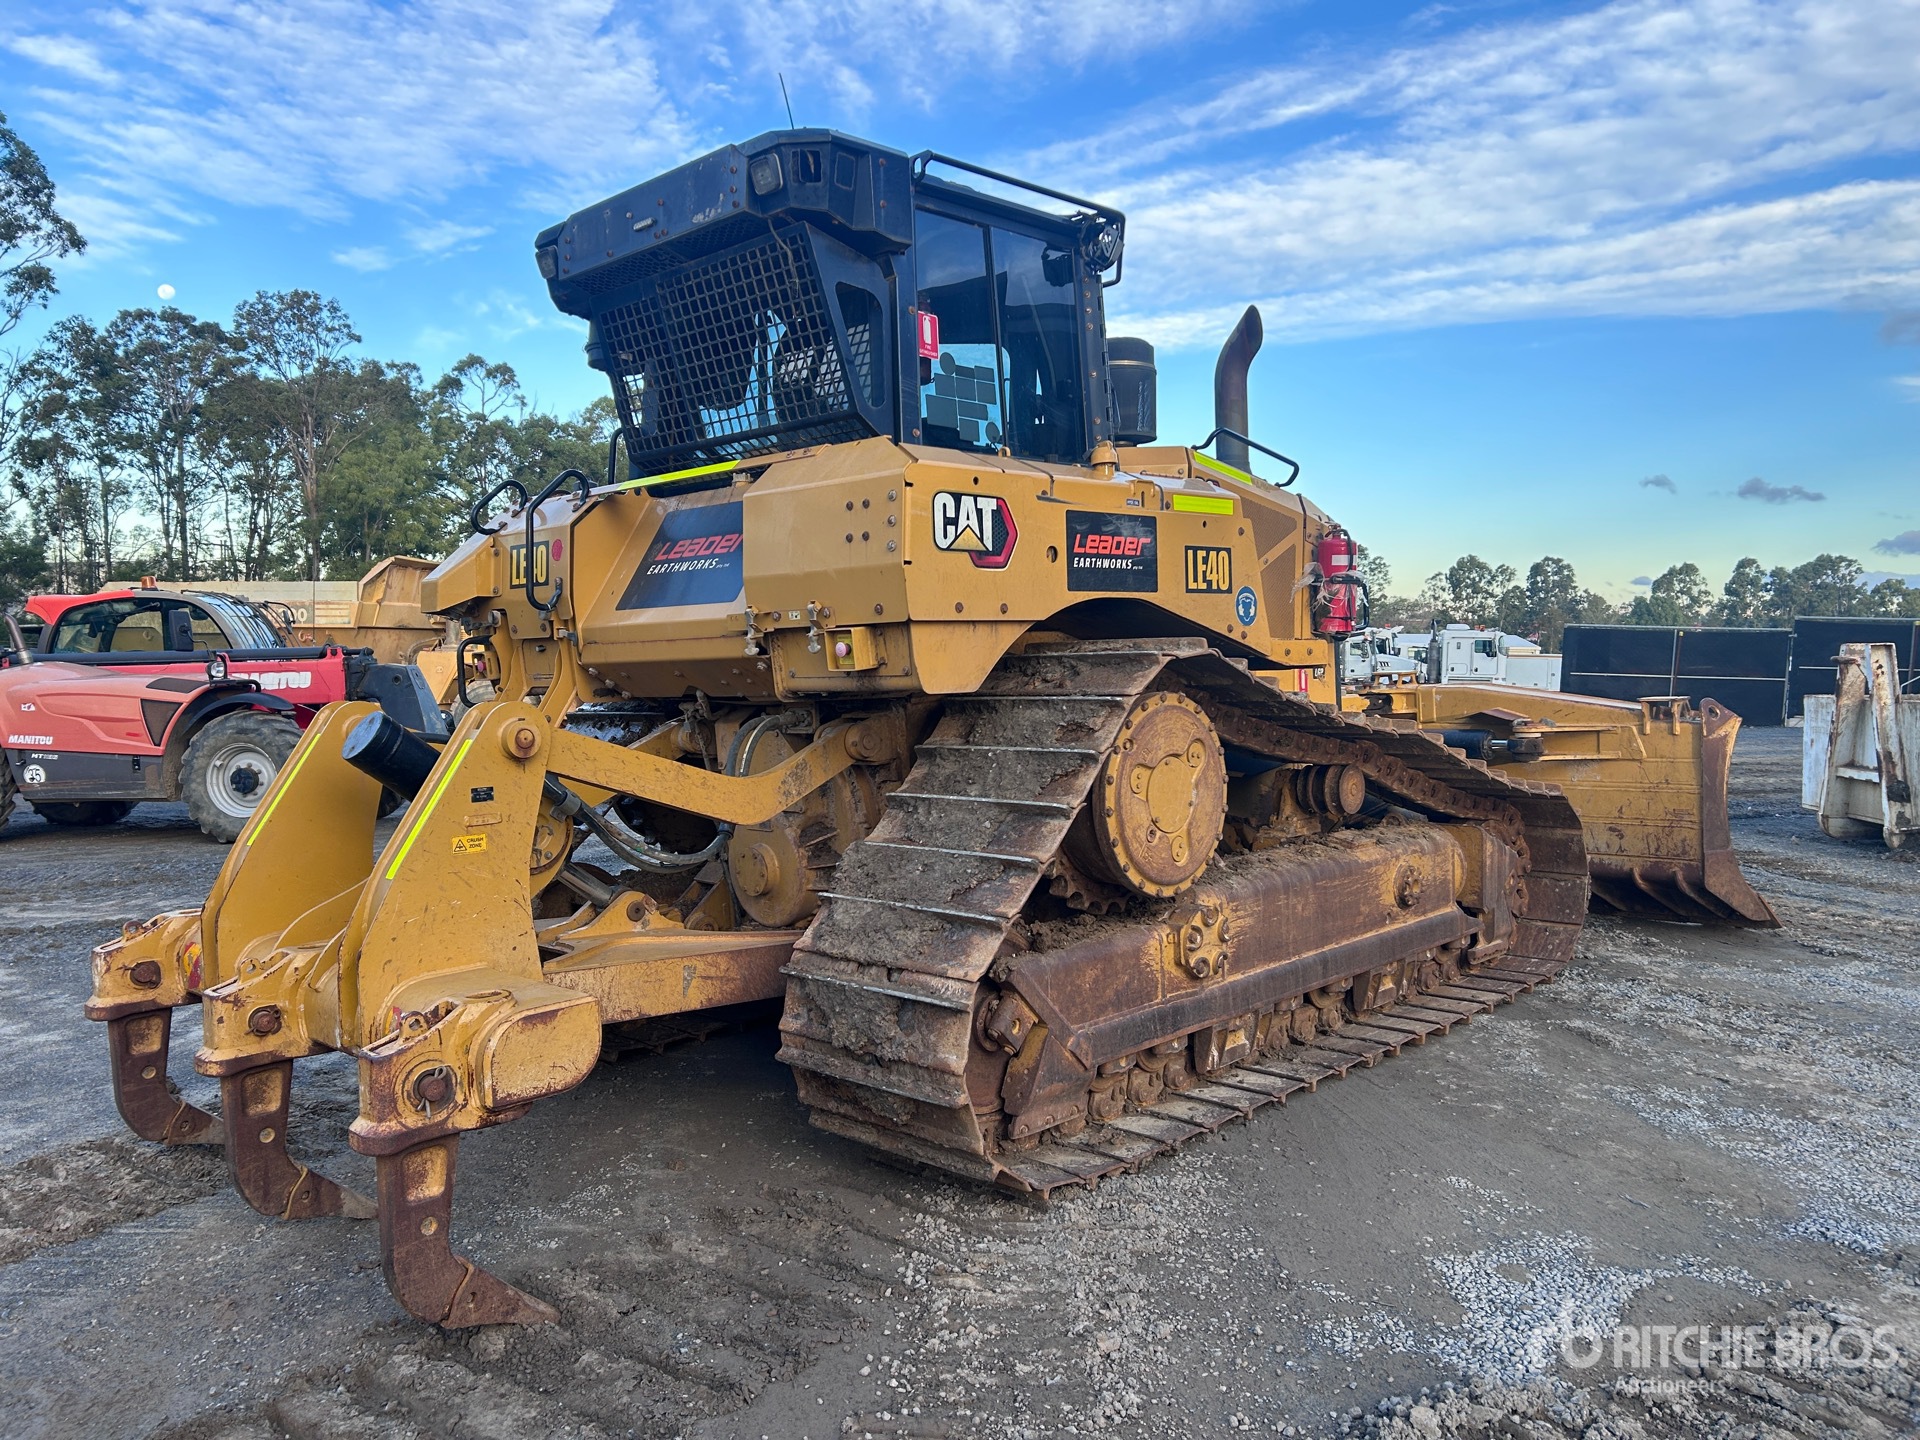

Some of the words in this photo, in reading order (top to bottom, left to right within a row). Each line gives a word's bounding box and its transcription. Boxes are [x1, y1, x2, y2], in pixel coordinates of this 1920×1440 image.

[933, 492, 997, 552] CAT
[511, 544, 547, 586] LE0
[646, 558, 719, 575] EARTHWORKS
[1073, 557, 1133, 570] EARTHWORKS
[1187, 549, 1230, 591] LE40
[8, 734, 54, 745] MANITOU
